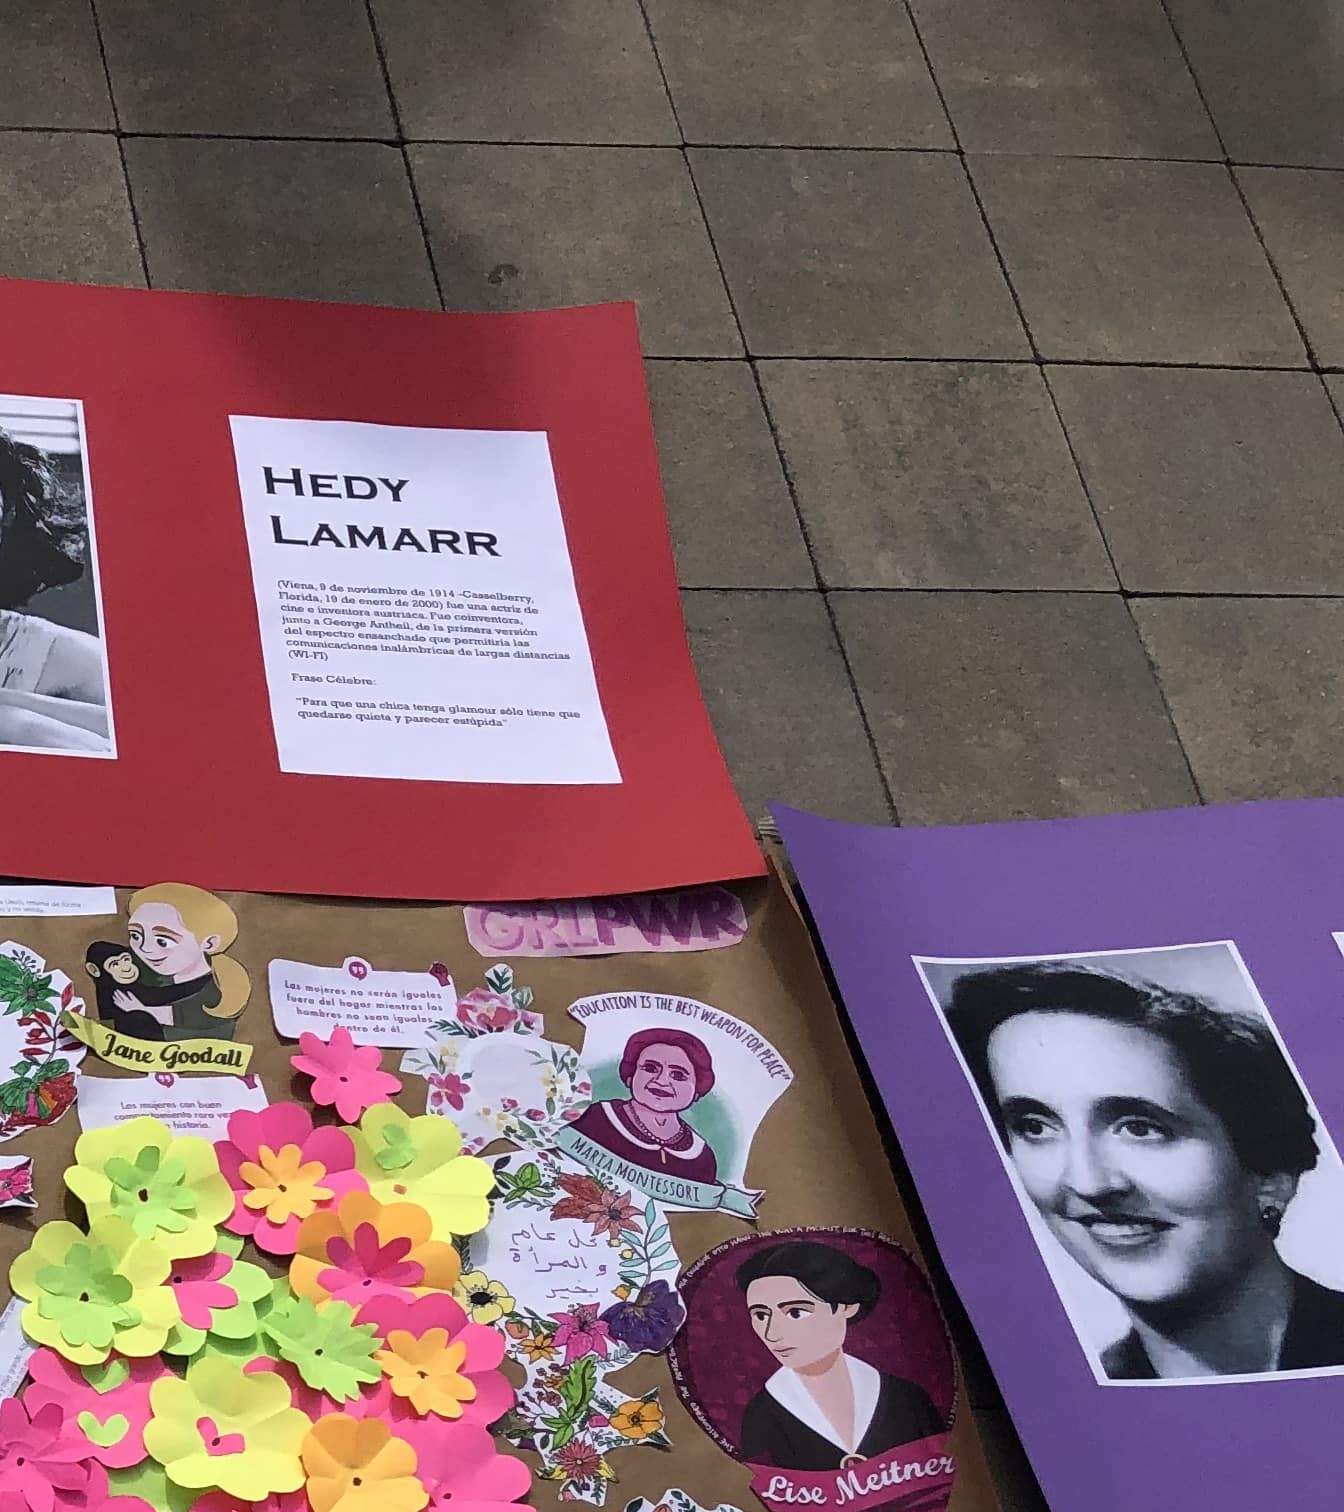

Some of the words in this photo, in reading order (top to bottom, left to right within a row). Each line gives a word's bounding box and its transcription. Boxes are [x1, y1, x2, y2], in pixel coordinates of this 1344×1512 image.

[298, 708, 352, 721] quedarse
[355, 713, 391, 723] quieta
[394, 715, 401, 724] y
[405, 714, 449, 726] parecer
[102, 1033, 155, 1064] Jane
[159, 1044, 243, 1068] Goodall
[571, 1138, 616, 1173] MARIA
[616, 1161, 700, 1201] MONTESSORI
[761, 1475, 827, 1505] Lise
[835, 1455, 956, 1506] Meitner
